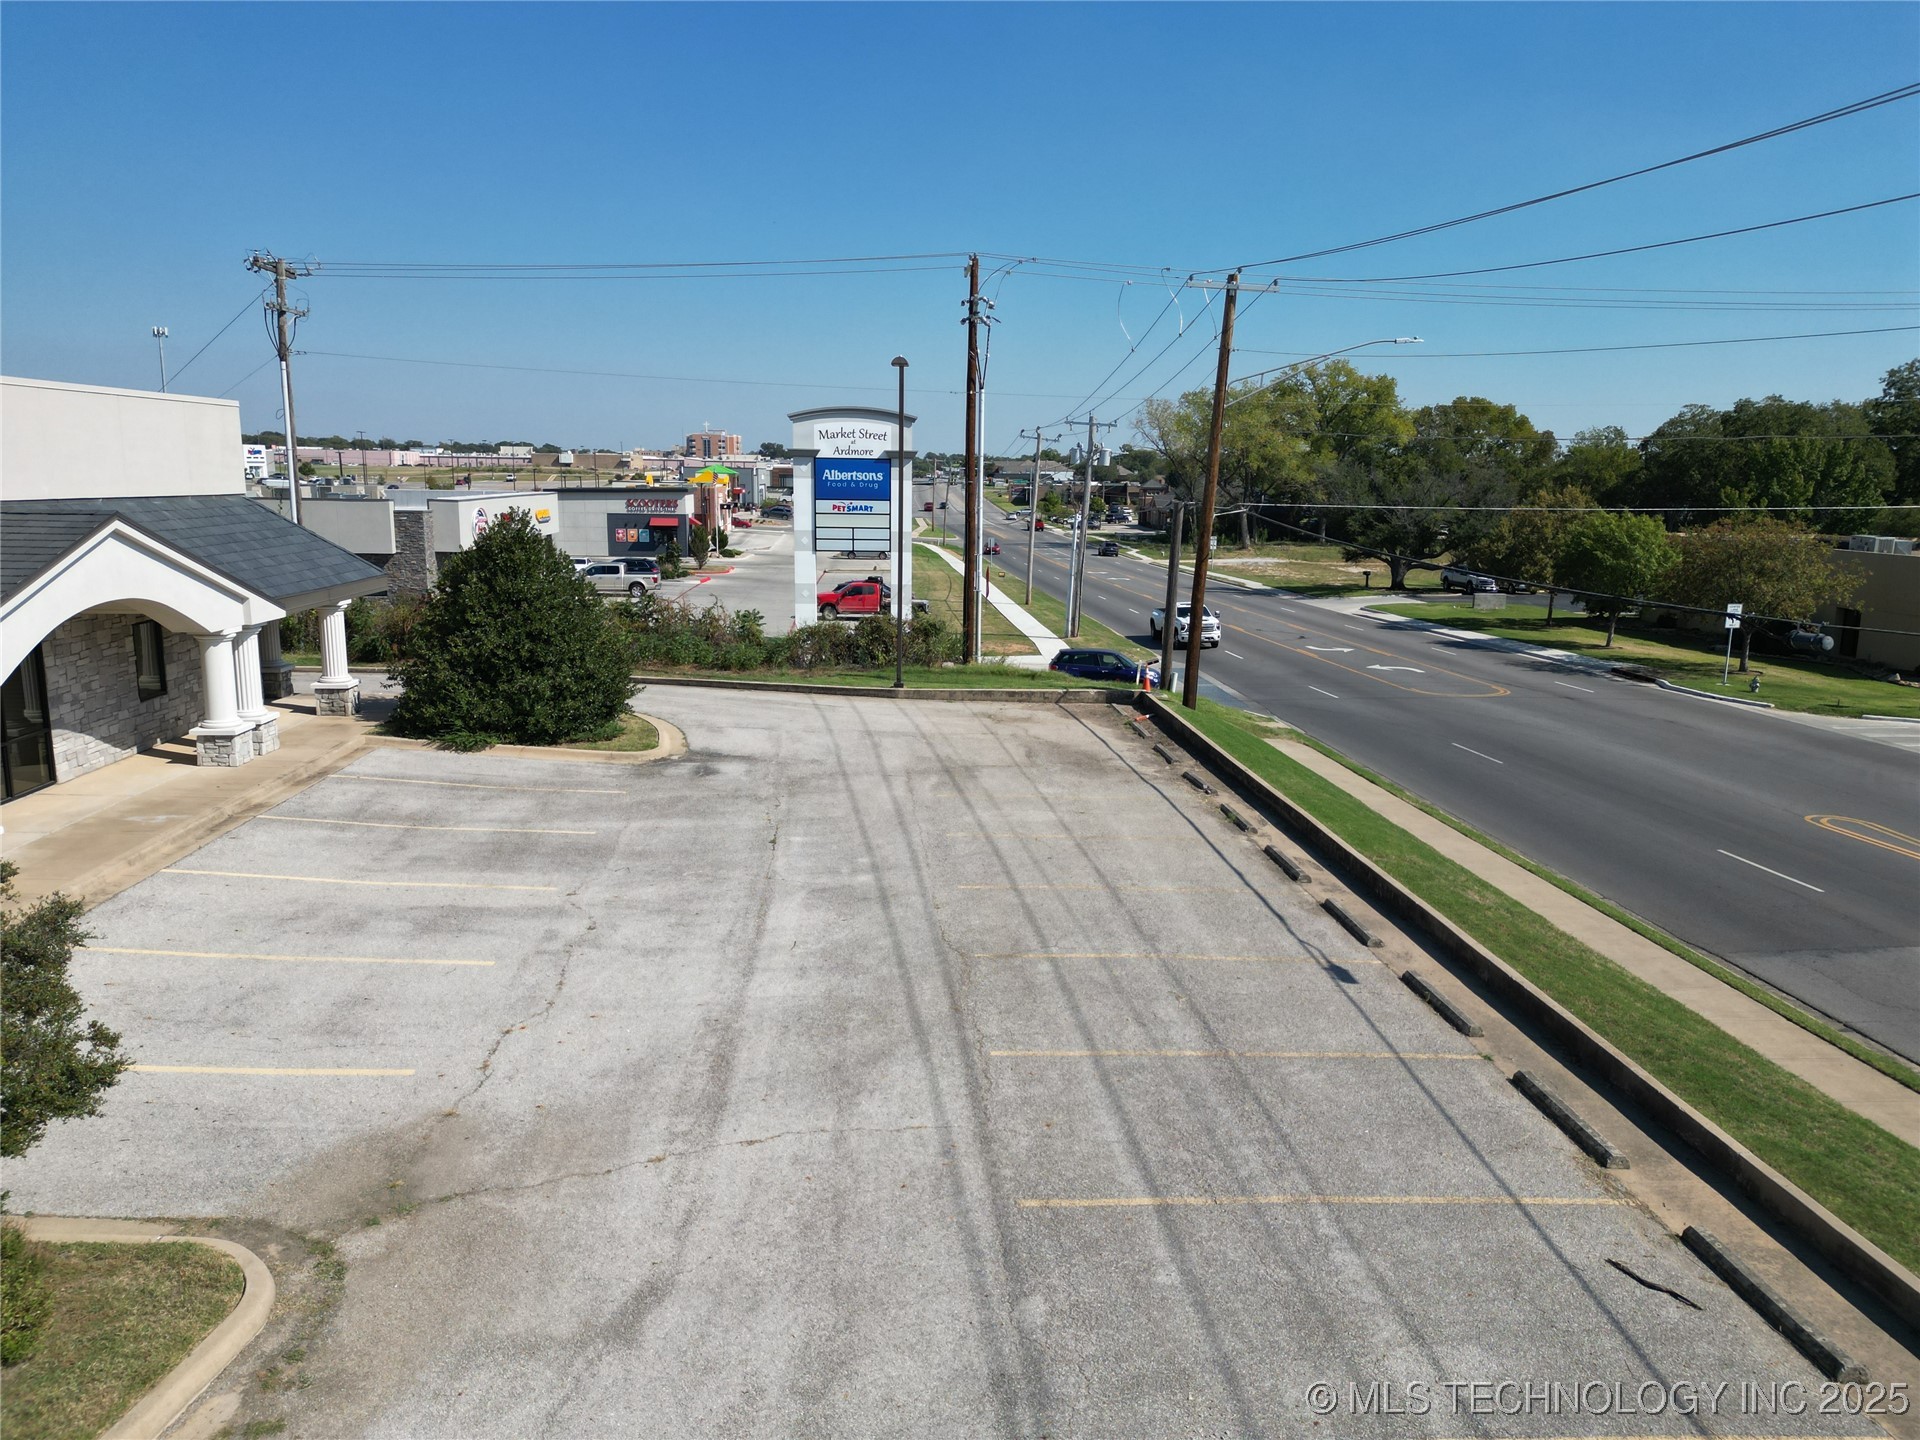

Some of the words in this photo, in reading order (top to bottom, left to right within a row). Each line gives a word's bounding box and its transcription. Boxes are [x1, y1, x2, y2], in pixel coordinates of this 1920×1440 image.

[818, 427, 856, 440] Market
[858, 428, 888, 441] Street
[833, 445, 874, 456] Ardmore
[822, 470, 883, 480] Albertsons
